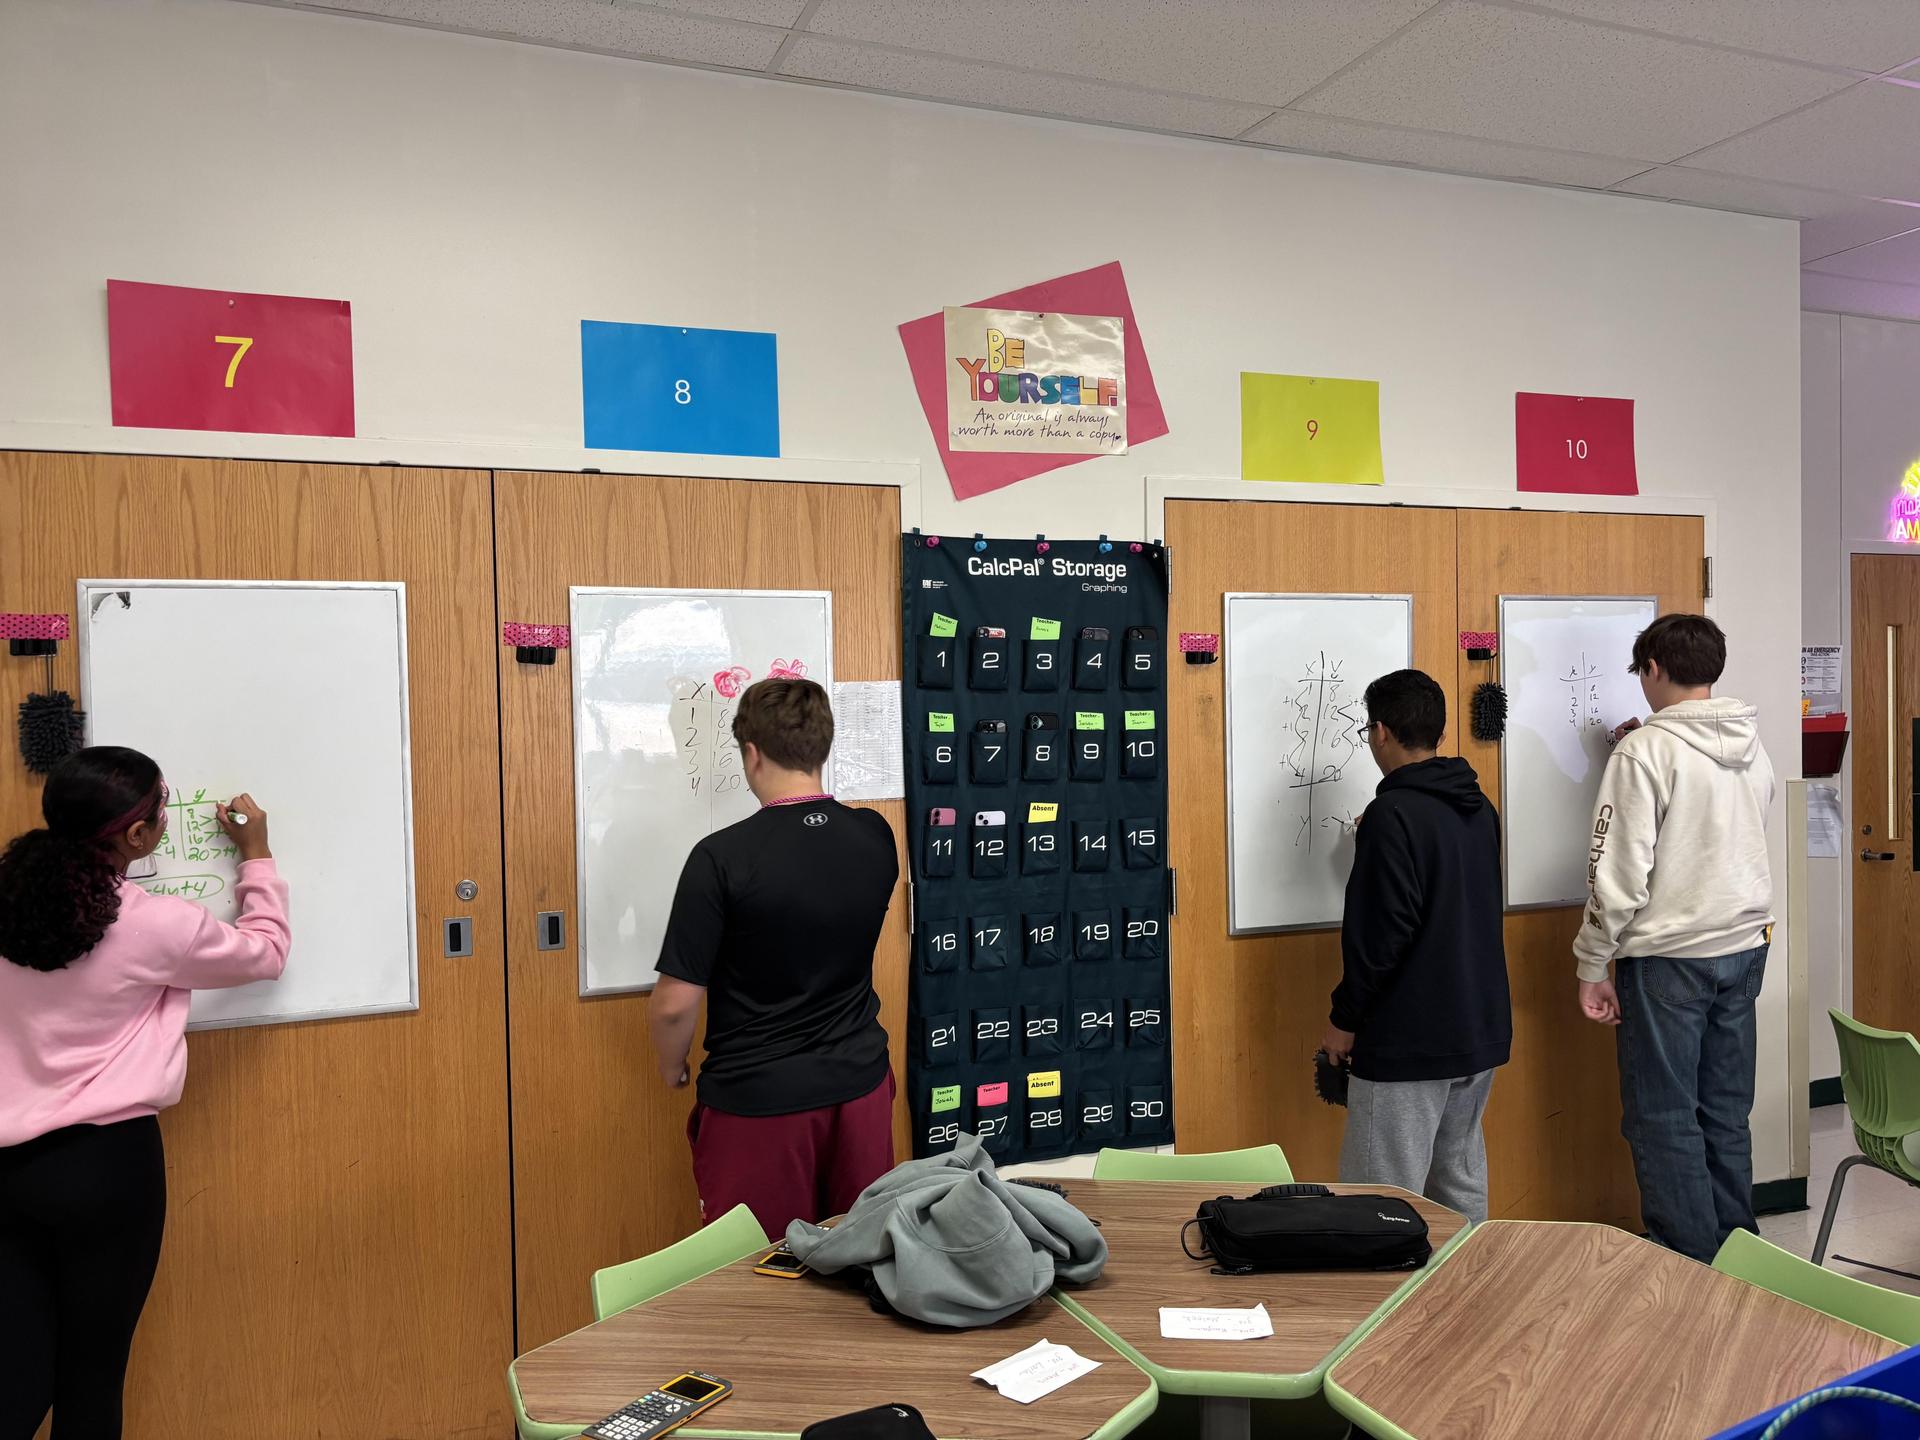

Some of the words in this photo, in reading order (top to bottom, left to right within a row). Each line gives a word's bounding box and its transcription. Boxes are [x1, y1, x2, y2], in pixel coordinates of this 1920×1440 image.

[987, 328, 1025, 373] BE
[215, 336, 254, 389] 7
[675, 380, 691, 404] 8
[973, 407, 994, 424] An
[998, 407, 1048, 428] original
[1054, 410, 1064, 426] is
[1067, 410, 1109, 431] always
[958, 424, 999, 437] worth
[1004, 426, 1035, 437] more
[1040, 423, 1072, 438] than
[1076, 430, 1085, 438] a
[1306, 420, 1318, 440] 9
[1565, 440, 1587, 459] 10
[1052, 557, 1127, 582] Storage
[1081, 583, 1128, 594] Graphing
[937, 651, 946, 668] 1
[983, 653, 1000, 669] 2
[1037, 654, 1053, 670] 3
[1087, 653, 1103, 669] 4
[1135, 655, 1151, 671] 5
[1323, 703, 1339, 722] 12
[684, 728, 701, 747] 2
[715, 730, 734, 747] 12
[936, 746, 952, 763] 6
[984, 746, 1001, 762] 7
[1036, 746, 1051, 762] 8
[1084, 744, 1100, 760] 9
[1127, 741, 1155, 758] 10
[686, 750, 700, 775] 3
[712, 752, 733, 769] 16
[714, 775, 741, 793] 20
[186, 821, 202, 832] 12
[188, 834, 204, 845] 16
[1028, 835, 1055, 852] 13
[1080, 836, 1107, 852] 14
[1128, 830, 1156, 846] 15
[165, 846, 176, 859] 4
[933, 839, 952, 856] 11
[976, 840, 1004, 856] 12
[975, 929, 1001, 947] 17
[1030, 926, 1055, 944] 18
[1082, 924, 1110, 941] 19
[1128, 921, 1159, 938] 20
[932, 934, 957, 952] 16
[1081, 1012, 1114, 1029] 24
[1130, 1010, 1161, 1027] 25
[932, 1026, 956, 1048] 21
[978, 1021, 1010, 1040] 22
[1027, 1019, 1058, 1038] 23
[1031, 1080, 1055, 1088] Absent
[1084, 1105, 1113, 1123] 29
[1131, 1101, 1164, 1118] 30
[978, 1116, 1009, 1137] 27
[1031, 1109, 1062, 1129] 28
[929, 1123, 959, 1144] 26
